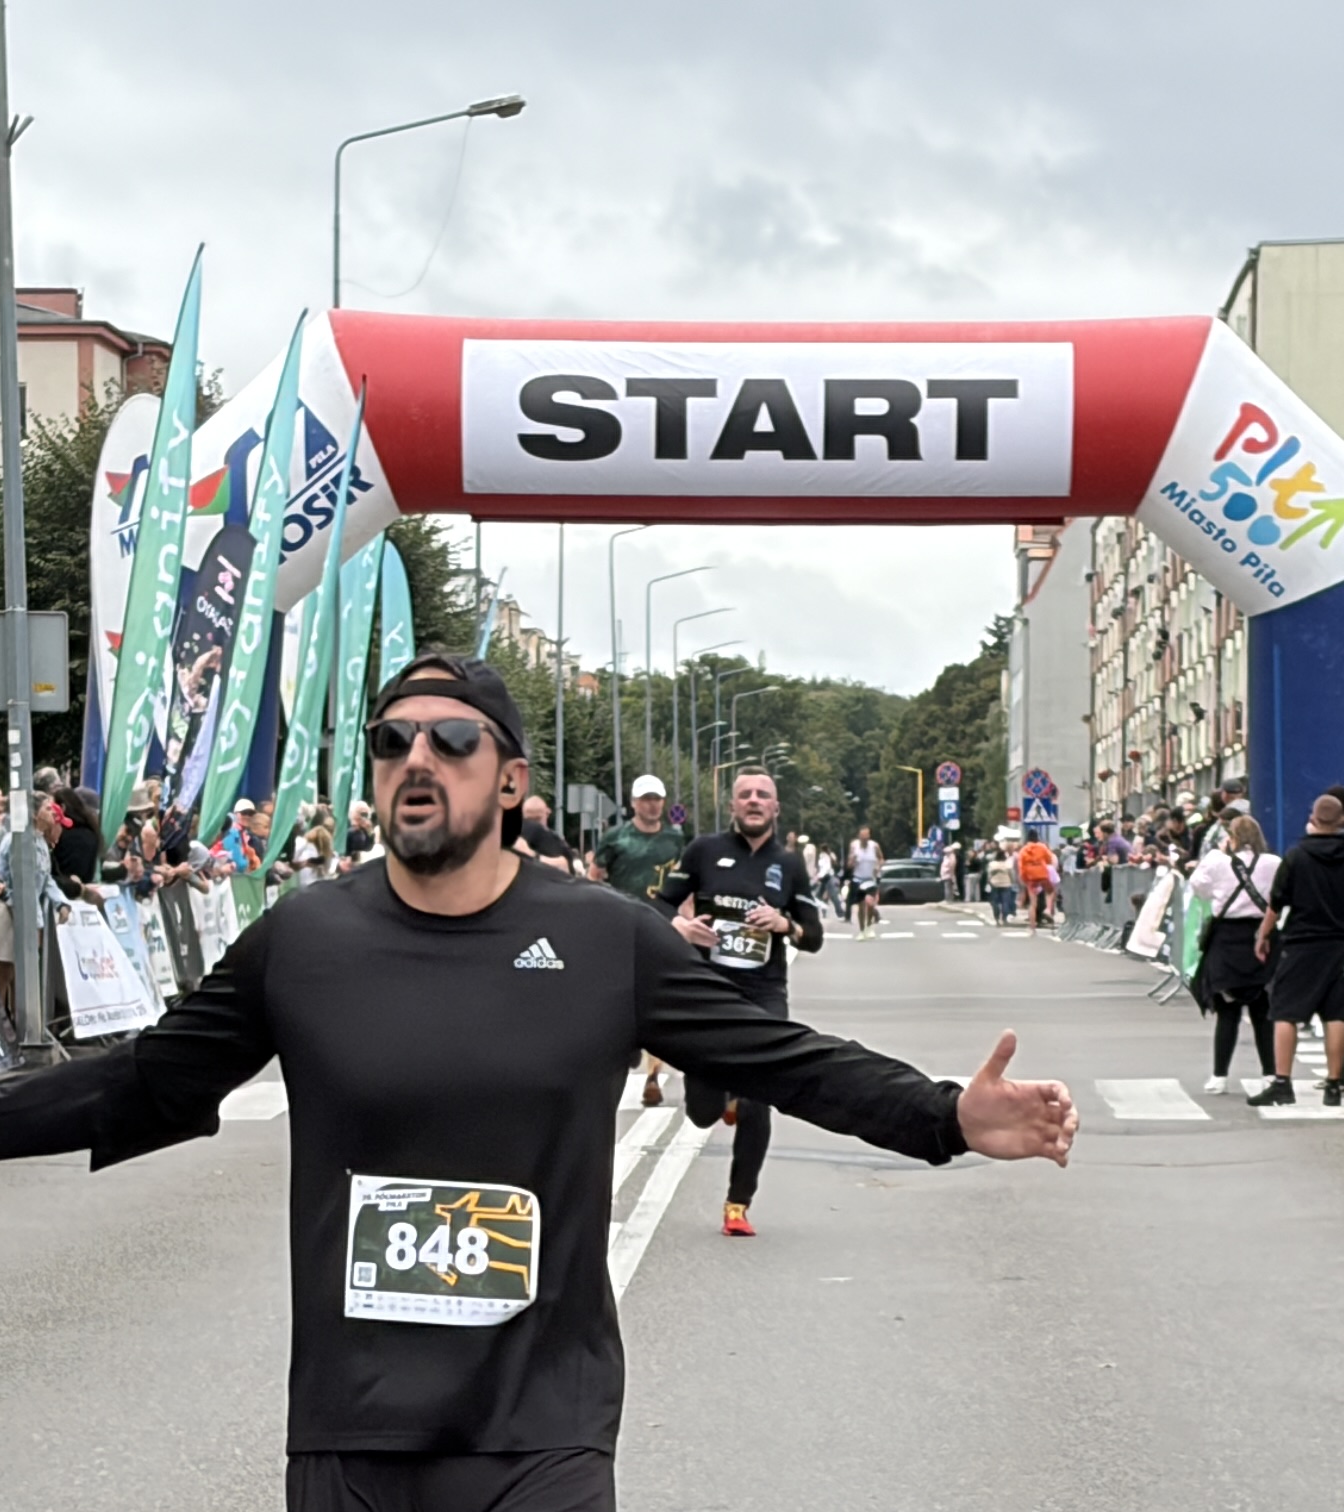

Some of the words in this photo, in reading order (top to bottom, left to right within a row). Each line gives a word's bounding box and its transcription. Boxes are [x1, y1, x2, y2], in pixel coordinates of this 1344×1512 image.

[516, 374, 1019, 462] START
[278, 463, 375, 565] OSiR
[1160, 481, 1238, 554] Miasto
[1239, 551, 1286, 598] Piła
[513, 956, 565, 970] adidas
[721, 934, 757, 954] 367
[385, 1222, 490, 1275] 848
